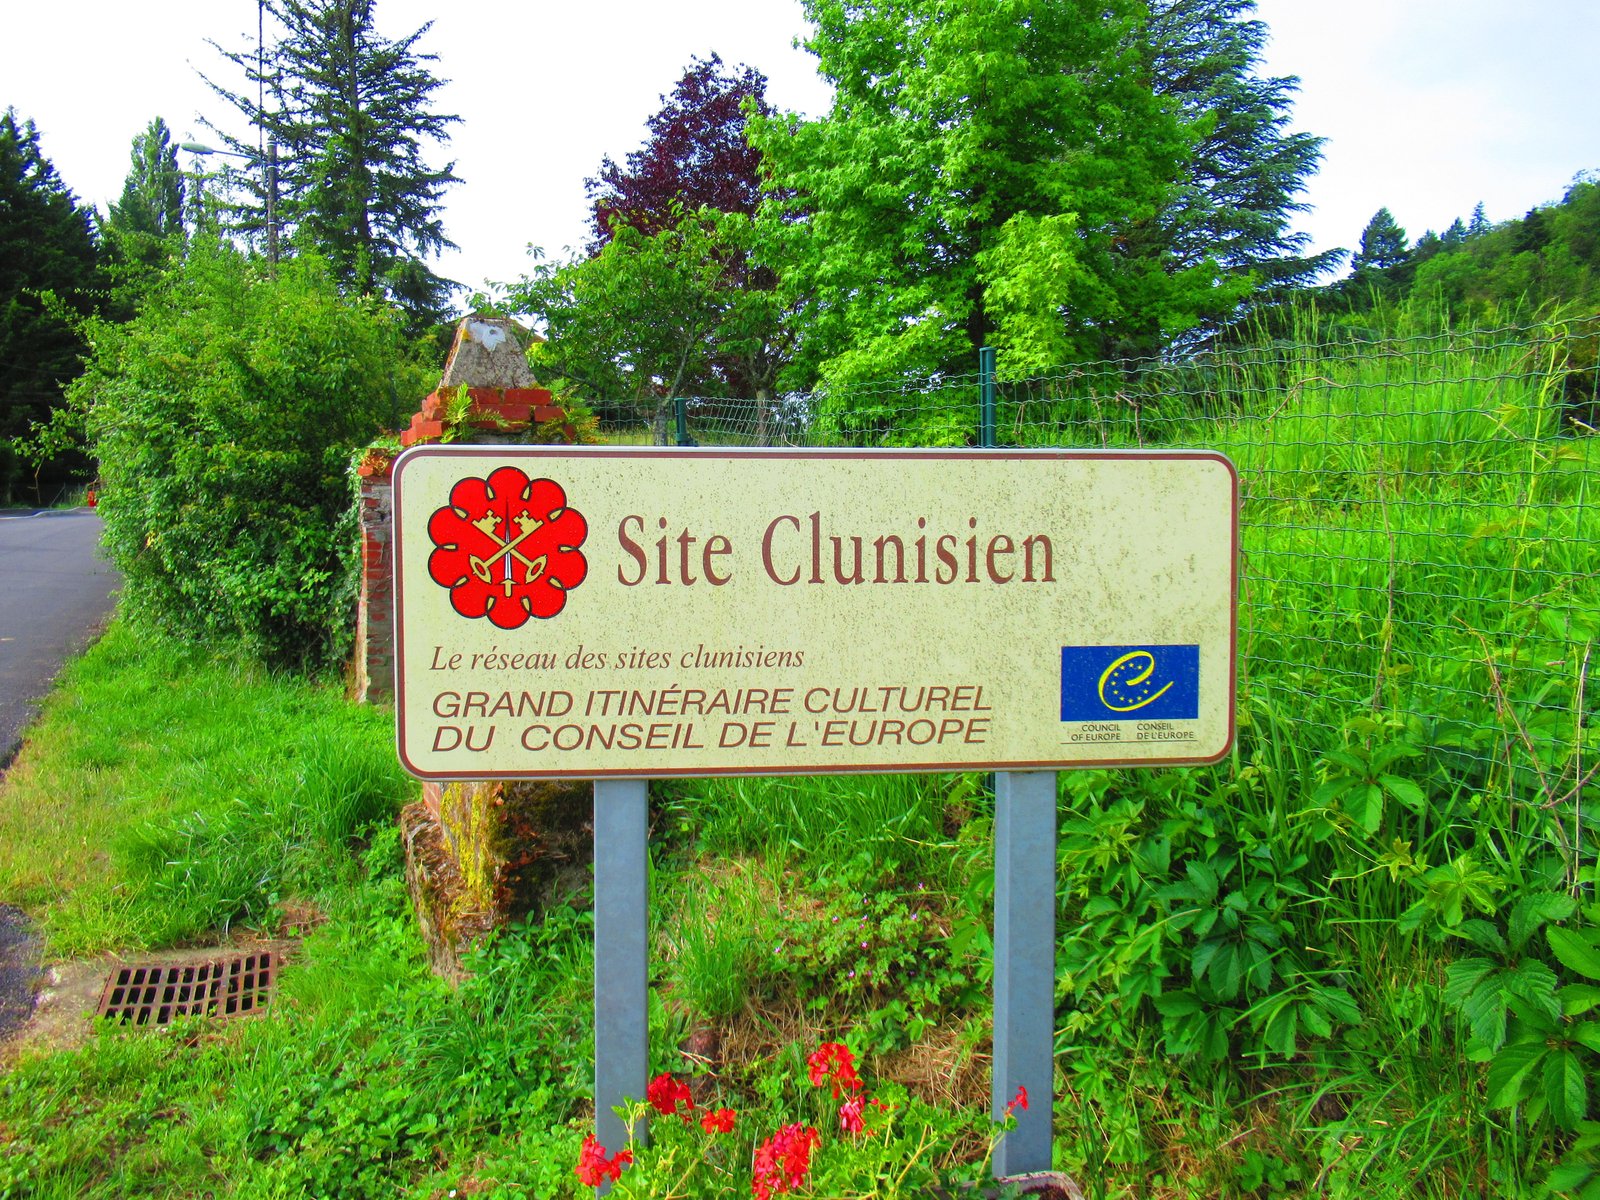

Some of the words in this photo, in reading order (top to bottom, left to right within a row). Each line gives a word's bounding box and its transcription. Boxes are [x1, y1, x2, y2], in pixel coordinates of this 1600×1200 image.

[618, 515, 733, 586] Site
[762, 511, 1057, 585] Clunisien
[429, 646, 462, 671] Le
[471, 645, 557, 670] réseau
[565, 644, 608, 669] des
[615, 646, 672, 670] sites
[680, 644, 805, 668] clunisiens
[432, 690, 574, 718] GRAND
[585, 683, 795, 716] ITINÉRAIRE
[804, 685, 992, 714] CULTUREL
[1081, 723, 1121, 732] COUNCIL
[1136, 722, 1175, 731] CONSEIL
[1136, 732, 1149, 740] DE
[1151, 731, 1195, 740] L'EUROPE
[431, 725, 496, 752] DU
[520, 723, 704, 751] CONSEIL
[718, 721, 776, 748] DE
[1071, 733, 1084, 742] OF
[1086, 732, 1121, 741] EUROPE
